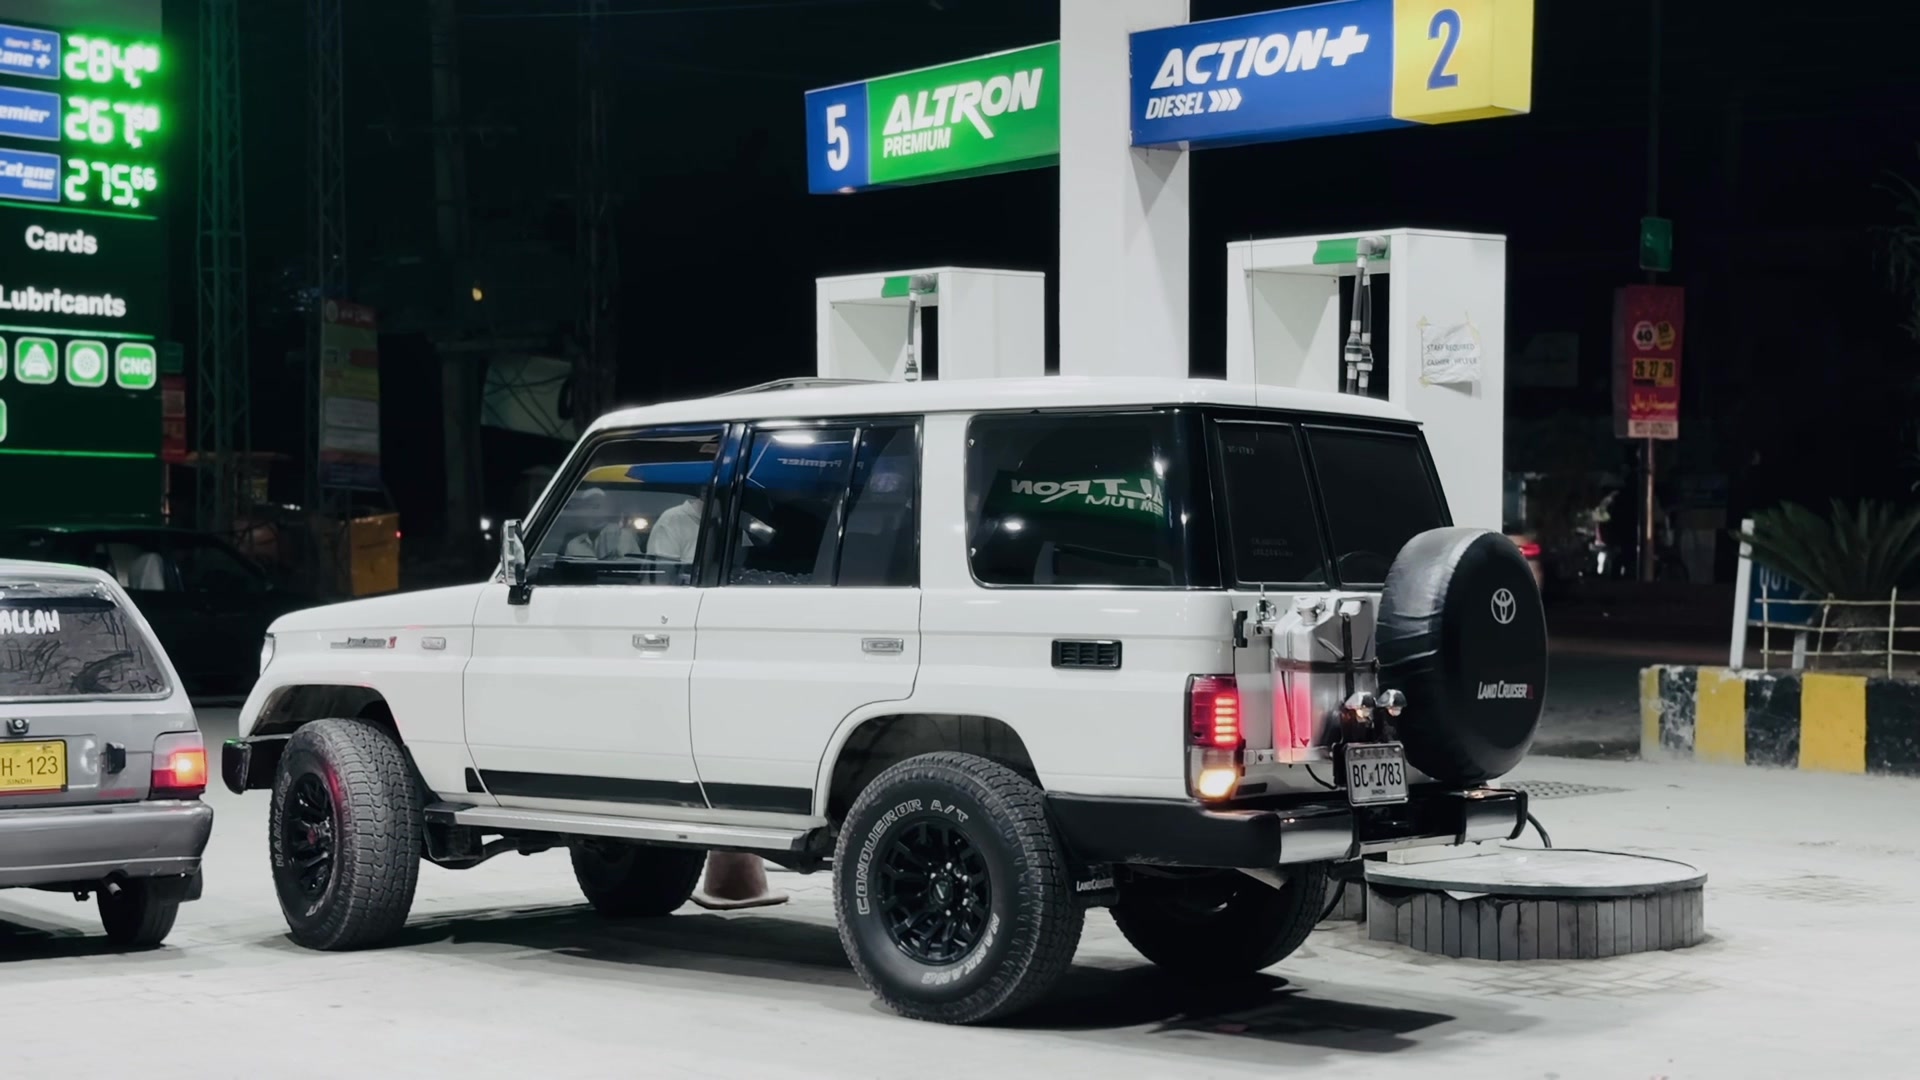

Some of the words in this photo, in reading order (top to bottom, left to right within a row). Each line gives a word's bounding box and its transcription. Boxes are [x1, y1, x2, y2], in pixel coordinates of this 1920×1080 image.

[1427, 9, 1462, 90] 2
[883, 68, 1043, 140] ALTRON
[1145, 90, 1204, 120] DIESEL
[826, 104, 850, 171] 5
[883, 127, 951, 158] PREMIUM
[25, 225, 98, 254] Cards
[0, 284, 127, 317] Lubricants
[120, 357, 152, 375] CNG
[855, 798, 923, 915] CONQUEROR
[930, 799, 969, 823] A/T
